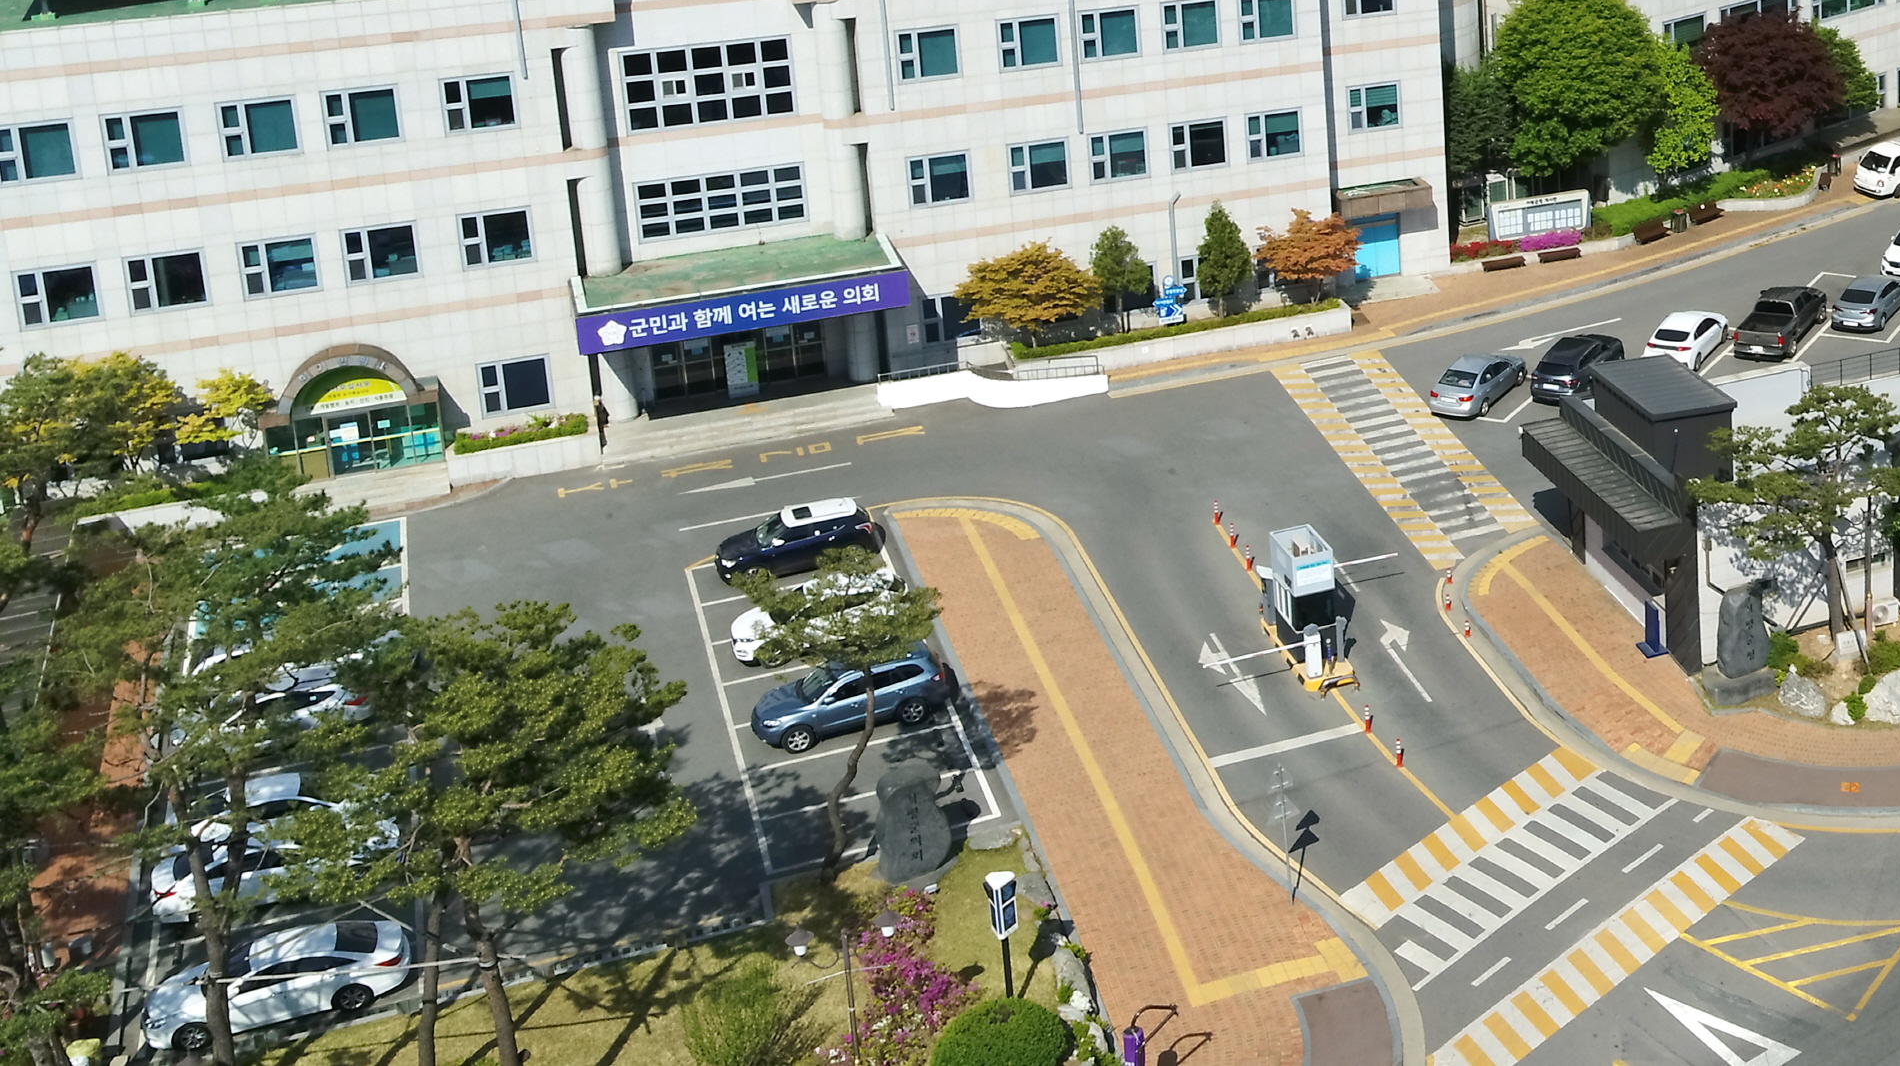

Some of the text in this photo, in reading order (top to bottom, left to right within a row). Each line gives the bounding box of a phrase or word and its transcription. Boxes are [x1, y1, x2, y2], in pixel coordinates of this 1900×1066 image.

[628, 282, 881, 338] 군민과 함께 여는 새로운 의회
